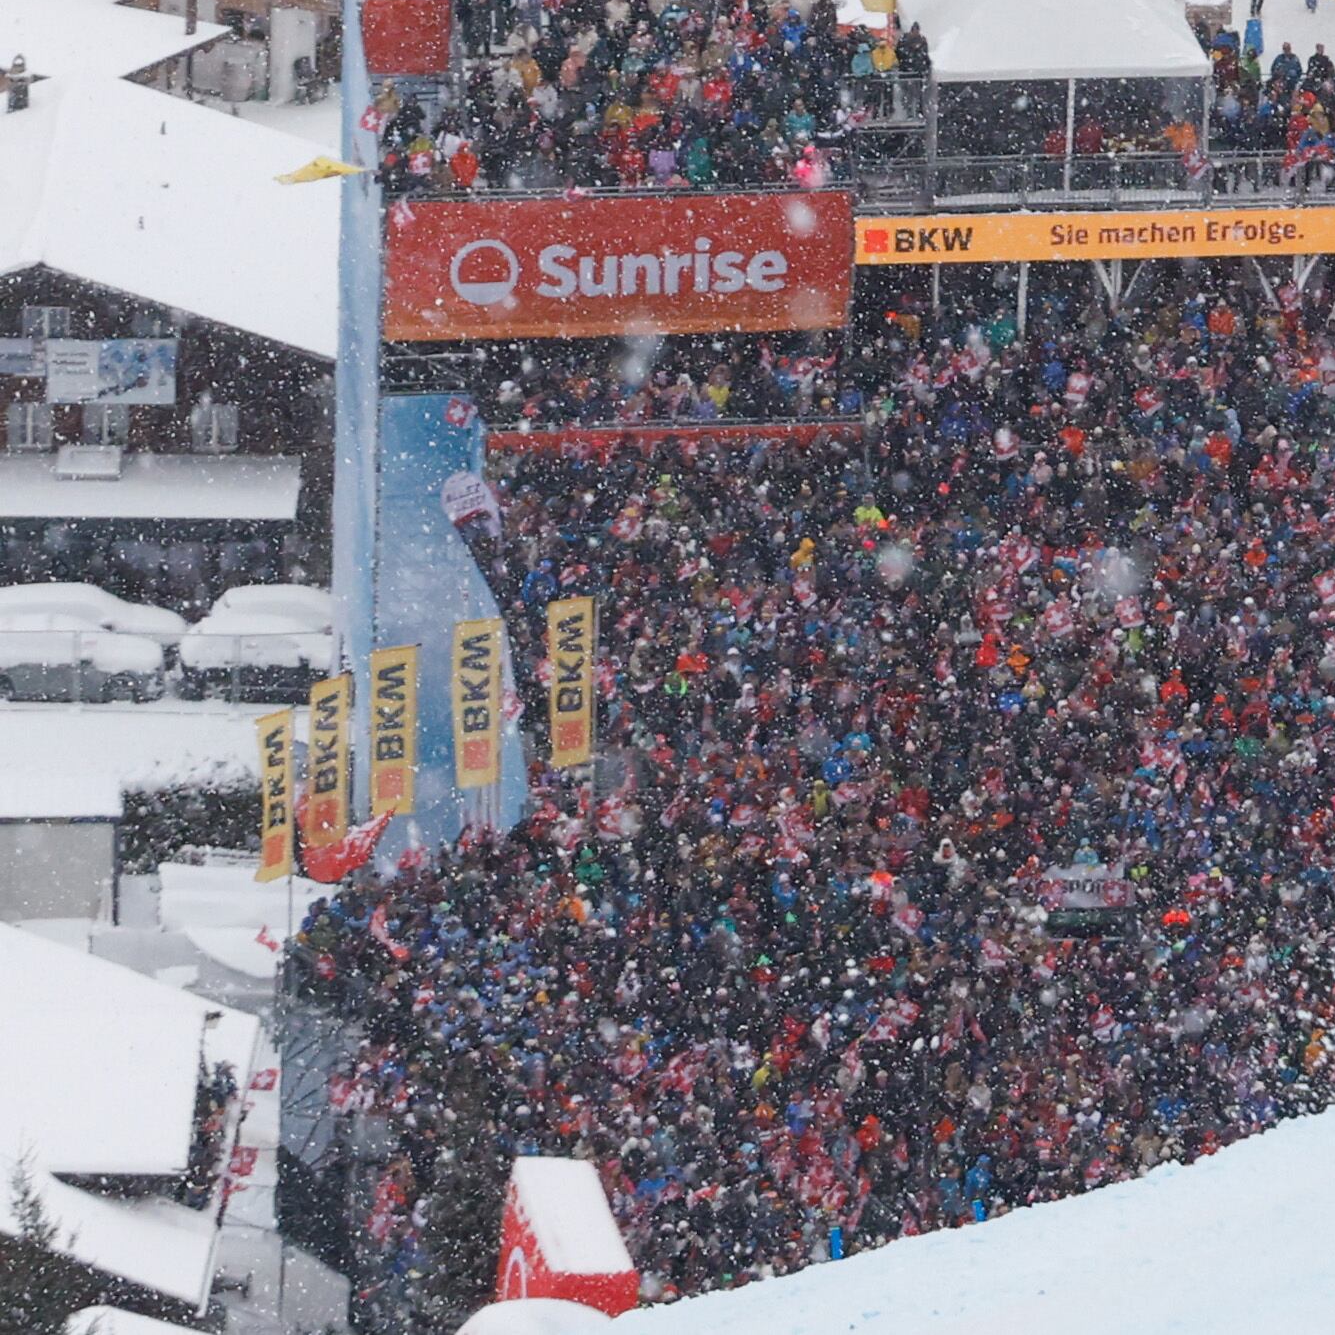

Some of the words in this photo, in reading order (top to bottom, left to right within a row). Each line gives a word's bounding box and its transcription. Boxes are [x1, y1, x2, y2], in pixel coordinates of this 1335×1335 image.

[894, 226, 974, 253] BKW
[1050, 224, 1089, 245] Sie
[1098, 222, 1196, 244] machen
[1205, 220, 1305, 244] Erfolge.
[536, 237, 788, 300] Sunrise
